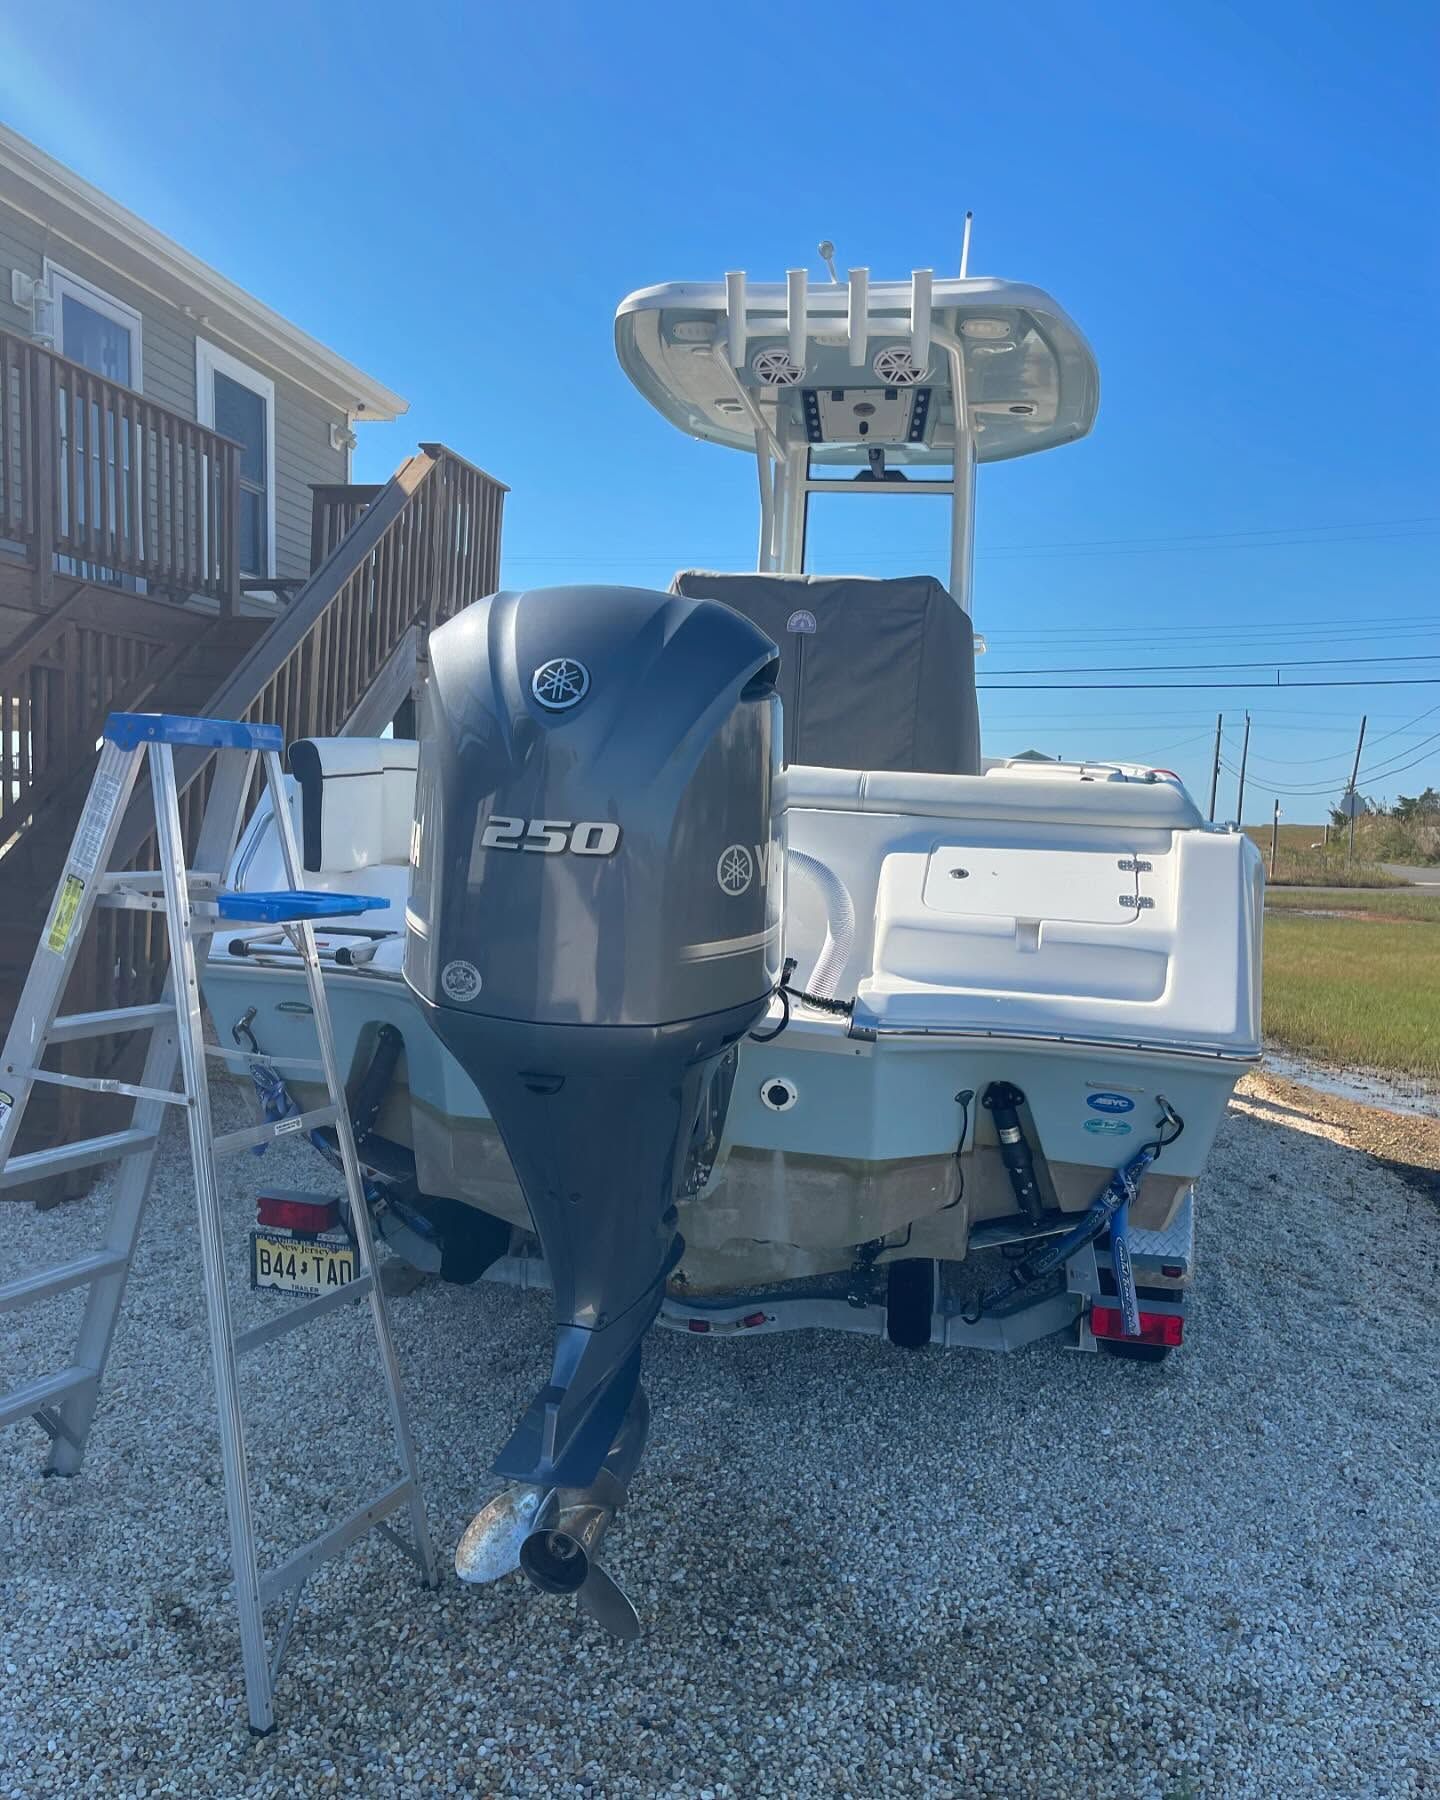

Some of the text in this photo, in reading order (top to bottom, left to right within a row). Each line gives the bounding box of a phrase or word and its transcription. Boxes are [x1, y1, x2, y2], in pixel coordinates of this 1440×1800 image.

[481, 815, 620, 854] 250
[278, 1240, 329, 1256] New Jersey
[260, 1248, 352, 1286] B44 TAD
[291, 1284, 319, 1293] TRAILER
